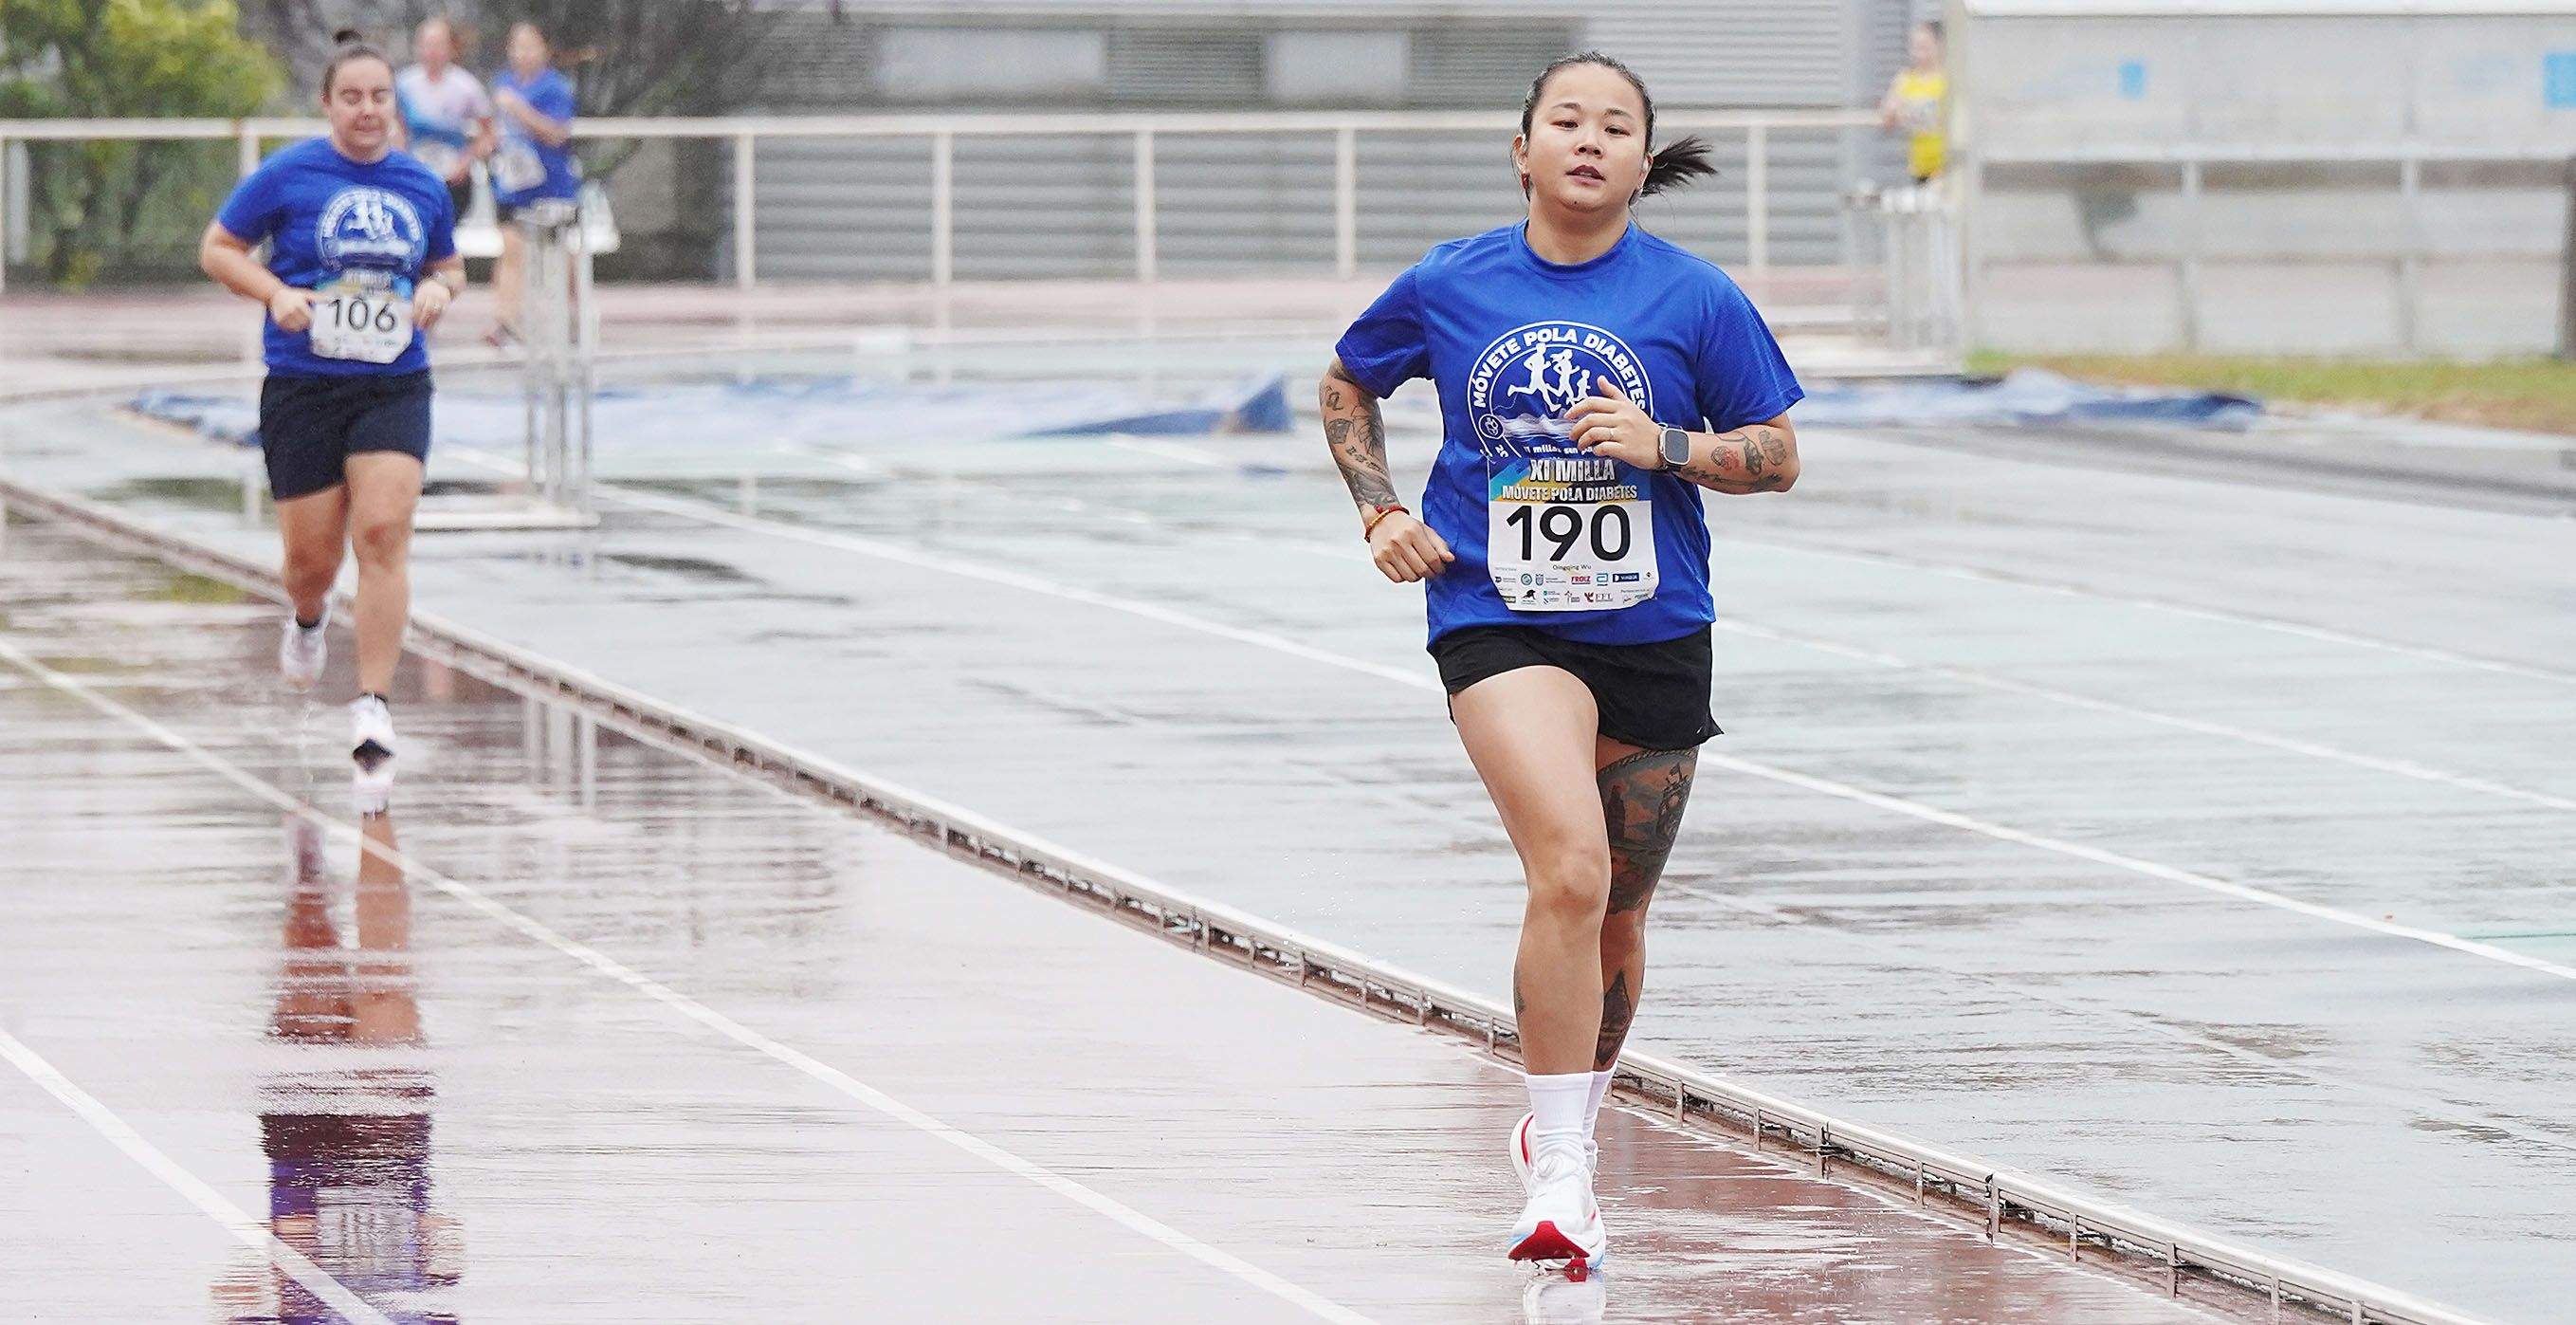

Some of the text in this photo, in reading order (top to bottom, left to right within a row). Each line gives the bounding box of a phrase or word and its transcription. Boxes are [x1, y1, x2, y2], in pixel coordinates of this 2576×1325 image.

[326, 298, 396, 332] 106
[1472, 338, 1522, 408] MÓVETE
[1524, 328, 1578, 346] POLA
[1529, 459, 1616, 483] XI MILLA
[1550, 485, 1583, 502] POLA
[1586, 484, 1637, 502] DIABETES
[1506, 505, 1632, 561] 190
